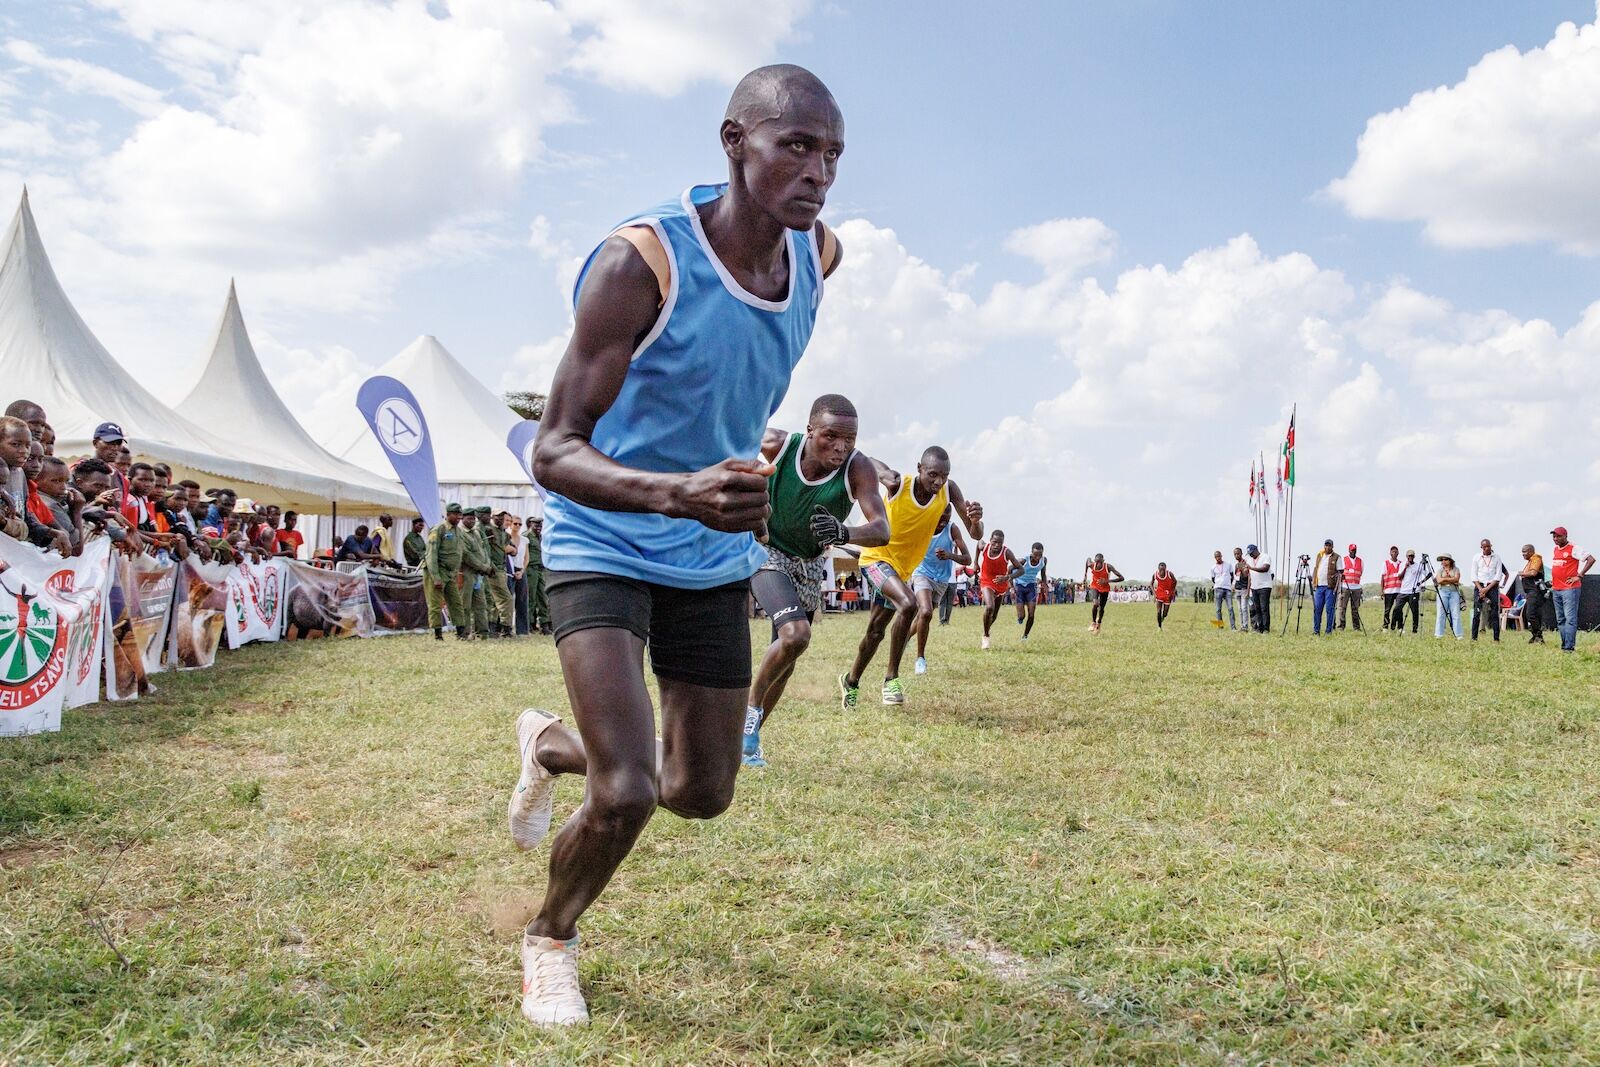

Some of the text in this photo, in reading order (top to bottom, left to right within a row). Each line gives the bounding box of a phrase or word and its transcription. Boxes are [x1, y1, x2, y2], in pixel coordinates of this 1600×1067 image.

[386, 407, 418, 444] A
[0, 689, 22, 706] ELI
[30, 648, 65, 698] TSAVO
